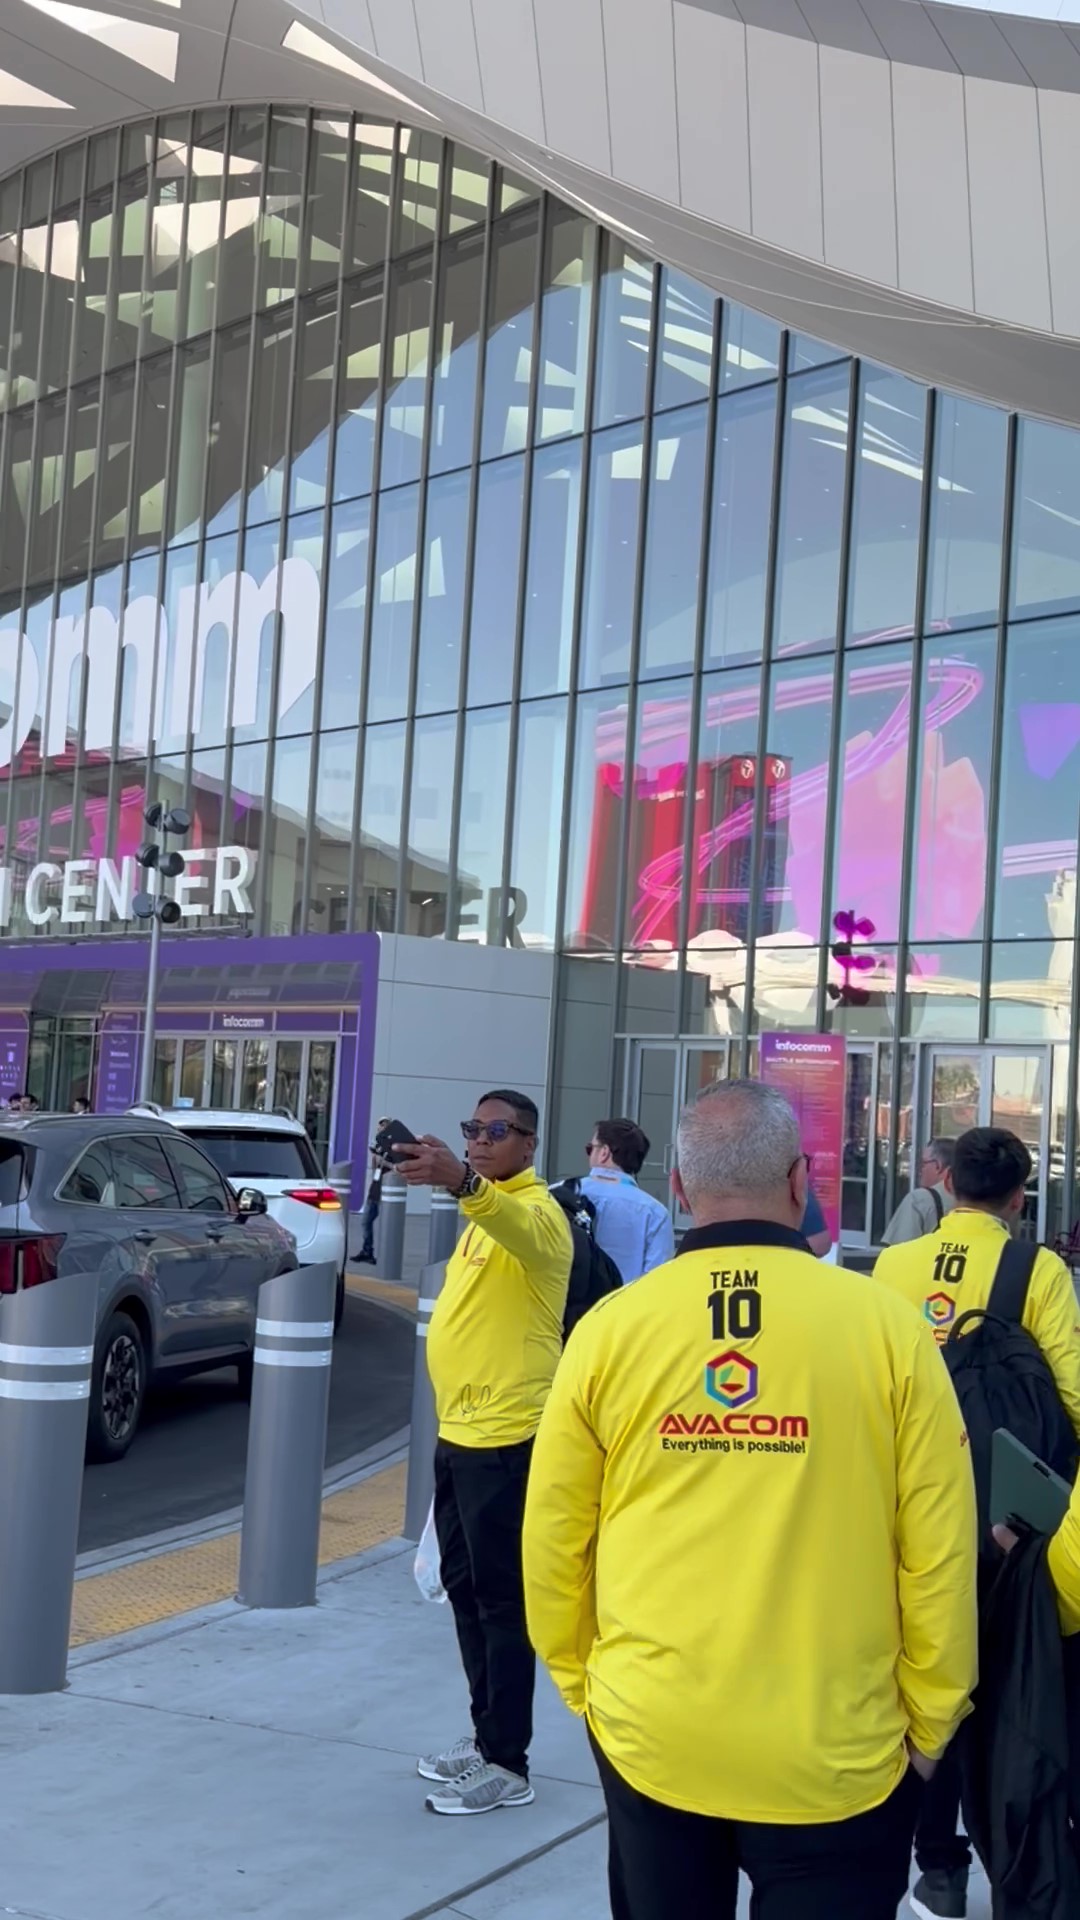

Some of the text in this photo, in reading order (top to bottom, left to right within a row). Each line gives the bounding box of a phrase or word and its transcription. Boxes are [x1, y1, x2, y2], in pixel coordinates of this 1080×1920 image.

[25, 846, 257, 926] CENER
[775, 1039, 832, 1053] infocomm
[940, 1242, 969, 1254] TEAM
[710, 1270, 759, 1289] TEAM
[933, 1253, 967, 1284] 10
[707, 1288, 762, 1340] 10
[658, 1413, 809, 1438] AVACOM
[662, 1438, 806, 1453] Everything is possible!
